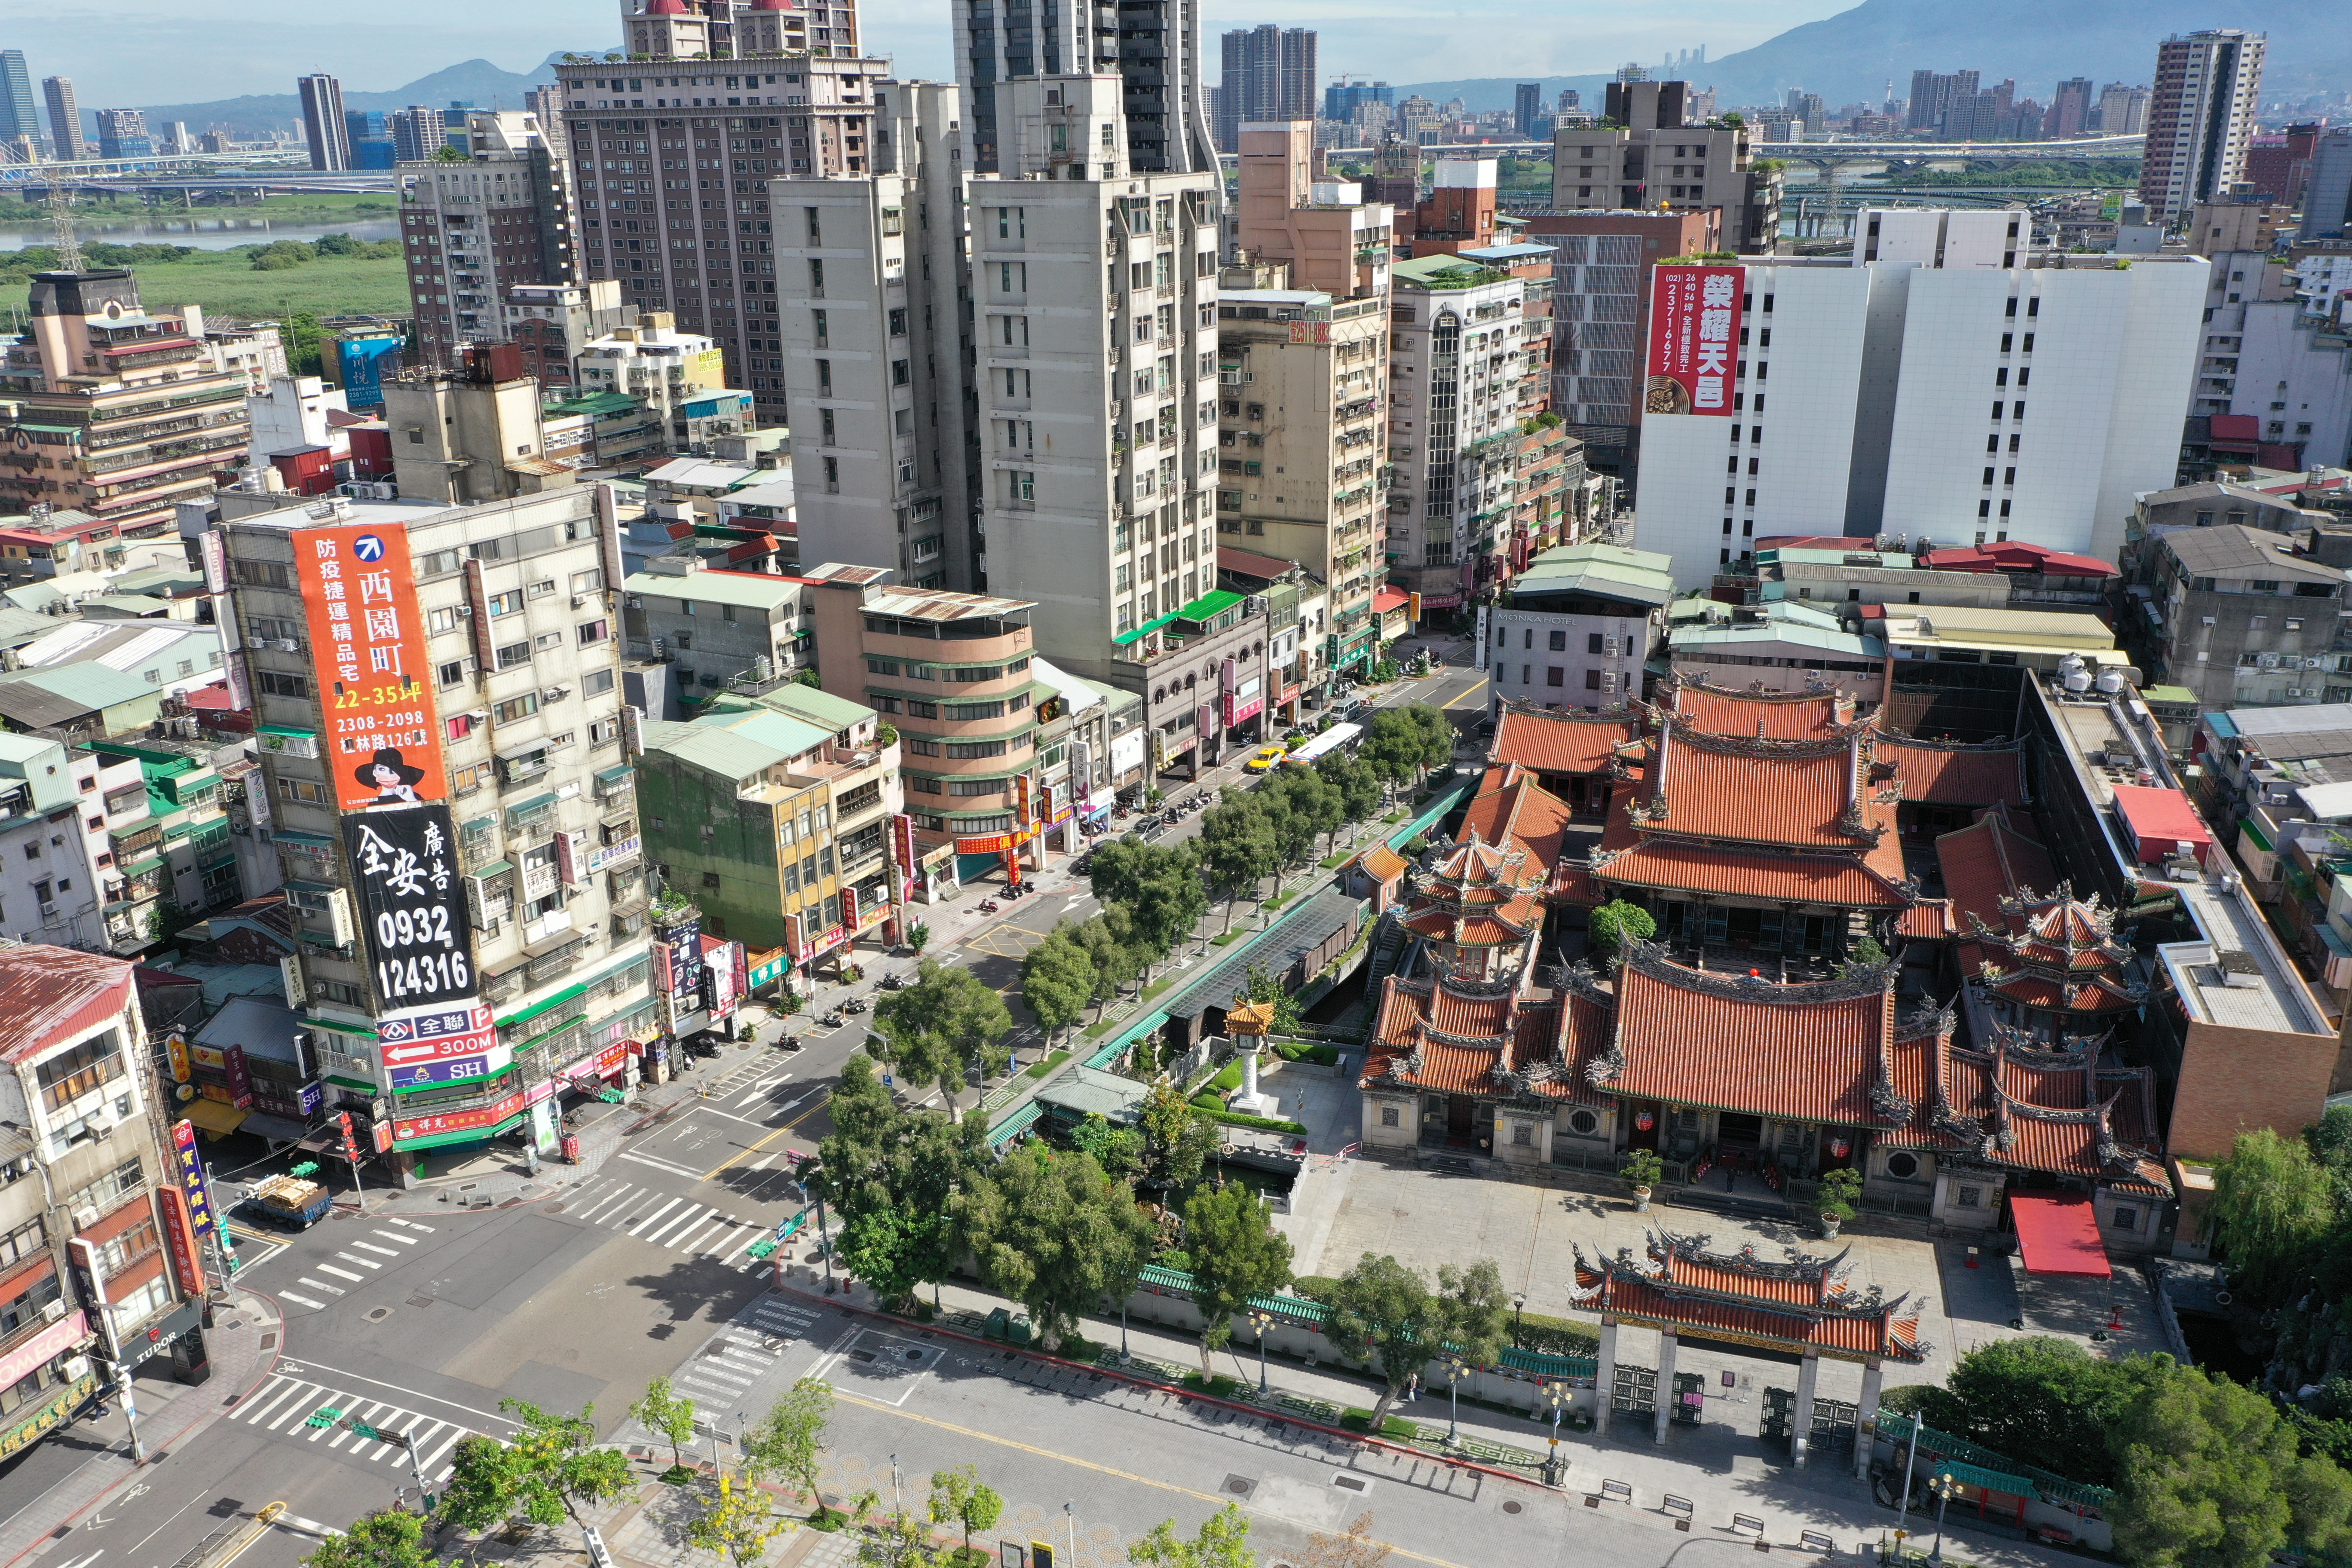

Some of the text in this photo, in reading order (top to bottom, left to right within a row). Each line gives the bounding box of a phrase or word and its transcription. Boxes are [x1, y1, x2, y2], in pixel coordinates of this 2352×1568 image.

[258, 329, 278, 340] OTEL
[1663, 284, 1676, 372] 23716677
[1679, 316, 1692, 373] 全新極致完工
[1695, 274, 1735, 408] 榮耀天邑
[211, 552, 223, 585] HOTEL
[315, 538, 359, 682] 防疫捷運精品宅
[357, 568, 404, 677] 西園町
[475, 603, 490, 652] HOTEL
[1498, 614, 1577, 625] MONKA HOTEL
[337, 710, 423, 732] 2308-2098
[340, 729, 428, 754] 桂林路126號
[1020, 779, 1028, 822] 順順佛俱
[357, 825, 427, 896] 全安
[423, 821, 450, 891] 廣告
[378, 906, 451, 948] 0932
[379, 951, 468, 998] 124316
[420, 1014, 464, 1034] 全聯
[475, 1007, 489, 1027] P
[440, 1033, 491, 1054] 300M
[450, 1061, 484, 1079] SH
[303, 1089, 321, 1108] SH
[418, 1118, 447, 1130] 祥光
[181, 1149, 211, 1228] 寶島鐘錶
[164, 1193, 191, 1280] 有幸福美學診所
[0, 1326, 80, 1384] OMEGA
[137, 1331, 177, 1363] TUDOR
